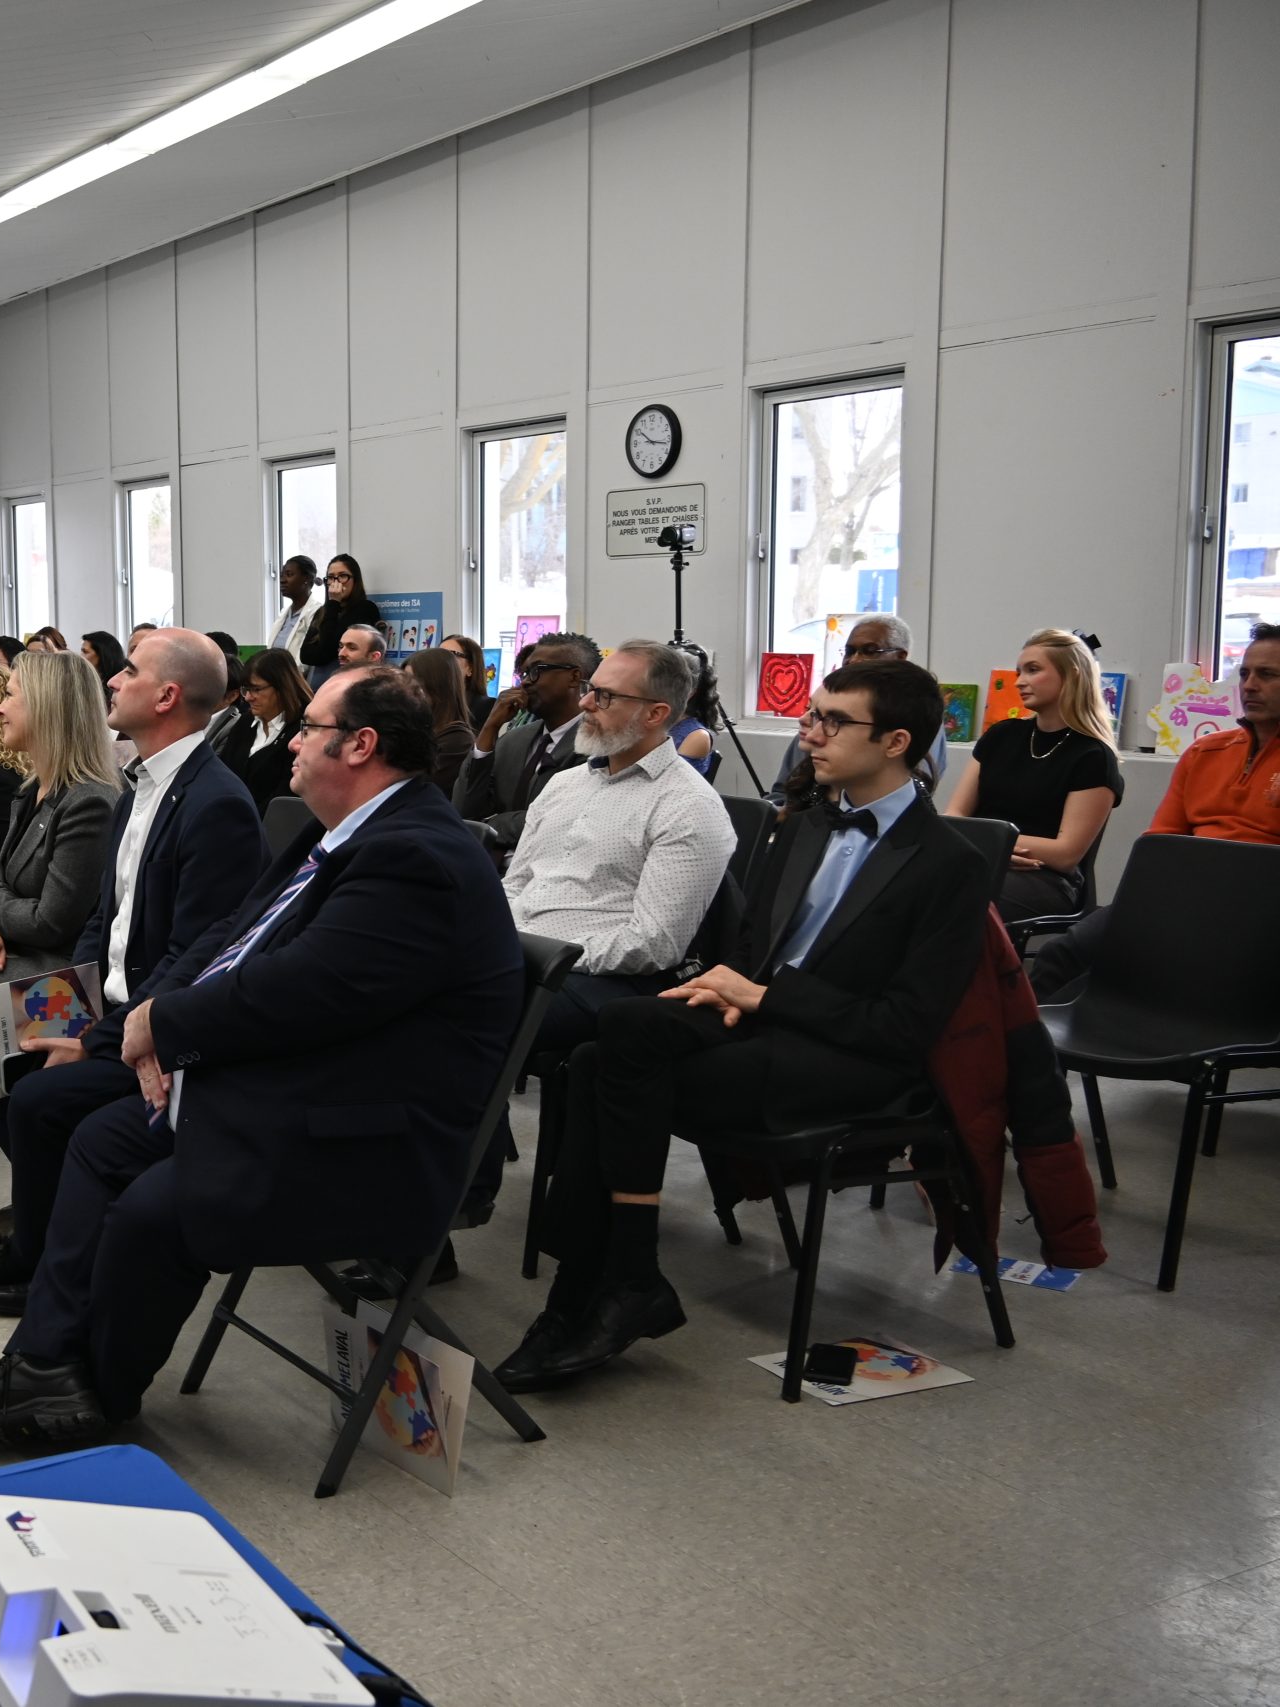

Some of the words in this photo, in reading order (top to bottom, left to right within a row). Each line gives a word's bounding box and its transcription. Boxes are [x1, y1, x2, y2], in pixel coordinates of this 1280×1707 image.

[649, 414, 655, 422] 12
[612, 509, 629, 517] NOUS
[630, 508, 647, 516] VOUS
[648, 505, 688, 515] DEMANDONS
[689, 504, 699, 512] DE
[612, 519, 636, 527] RANGER
[638, 517, 660, 525] TABLES
[640, 527, 660, 535] VOTRE
